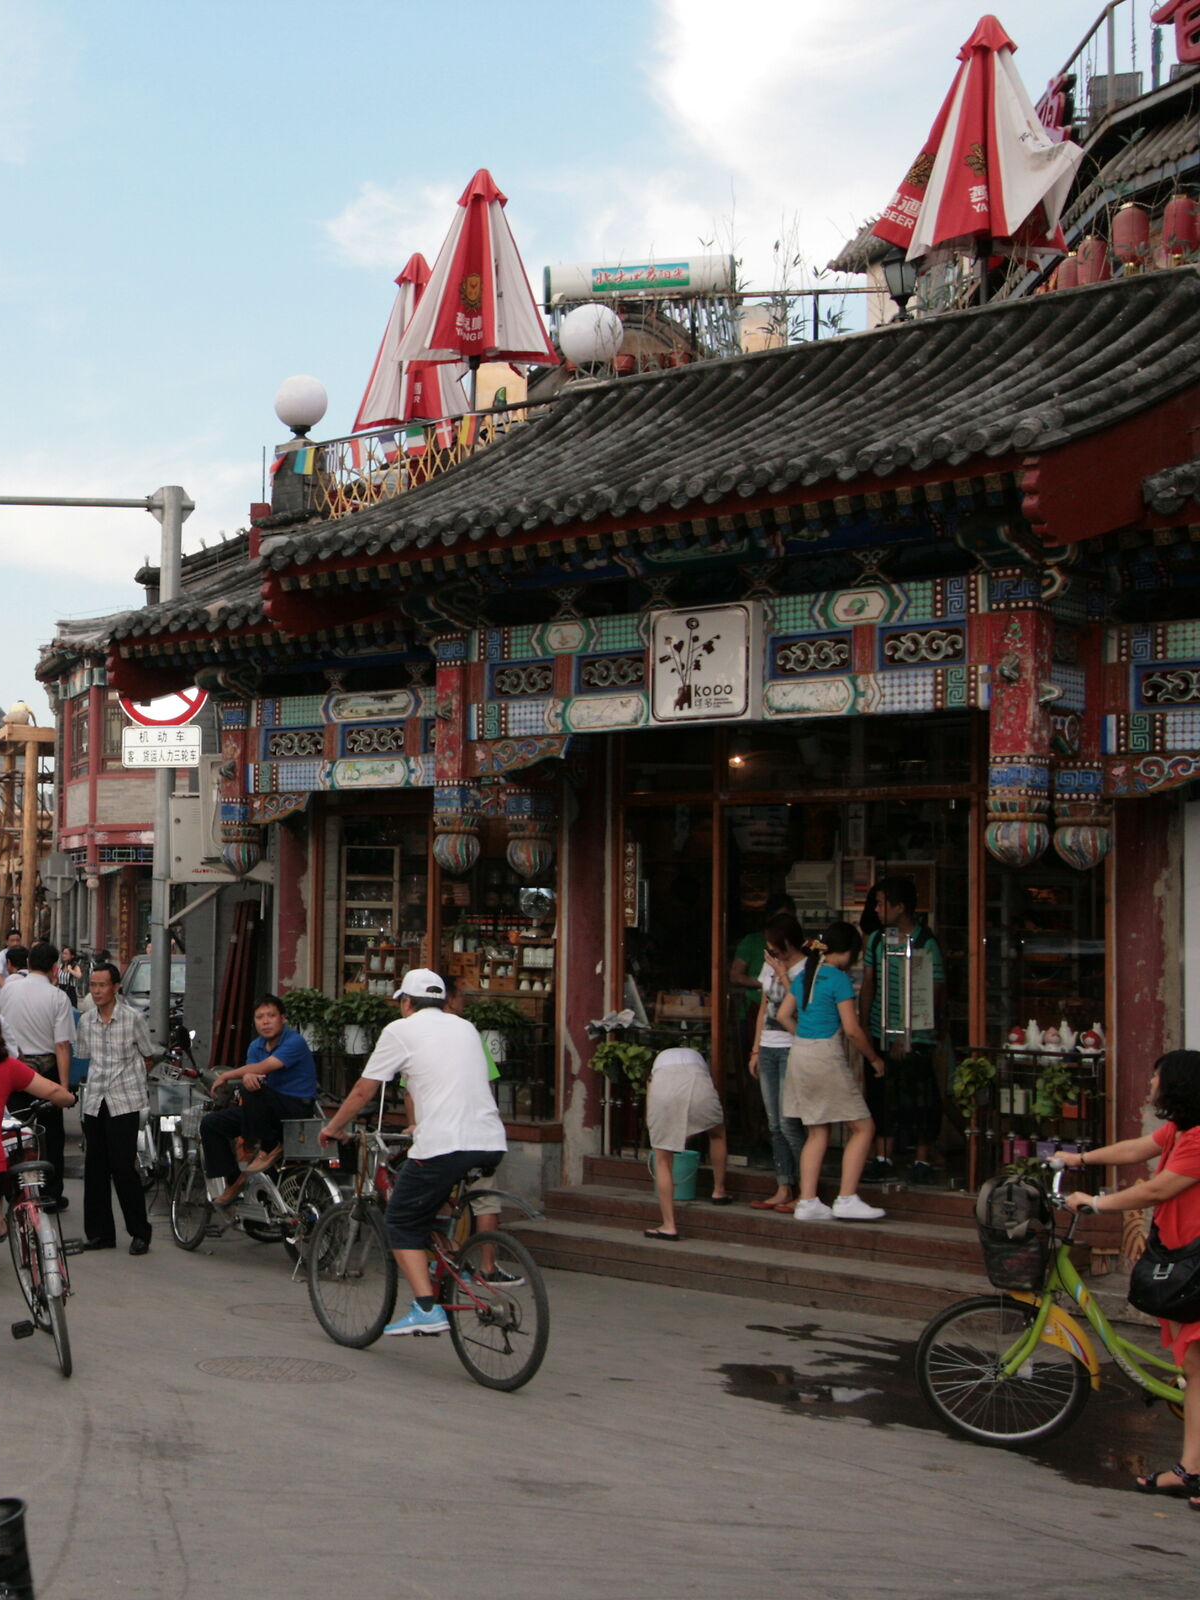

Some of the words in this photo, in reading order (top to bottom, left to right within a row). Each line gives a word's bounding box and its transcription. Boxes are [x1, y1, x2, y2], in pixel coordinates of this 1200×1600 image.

[882, 209, 915, 229] BEER
[139, 730, 184, 743] 机动车
